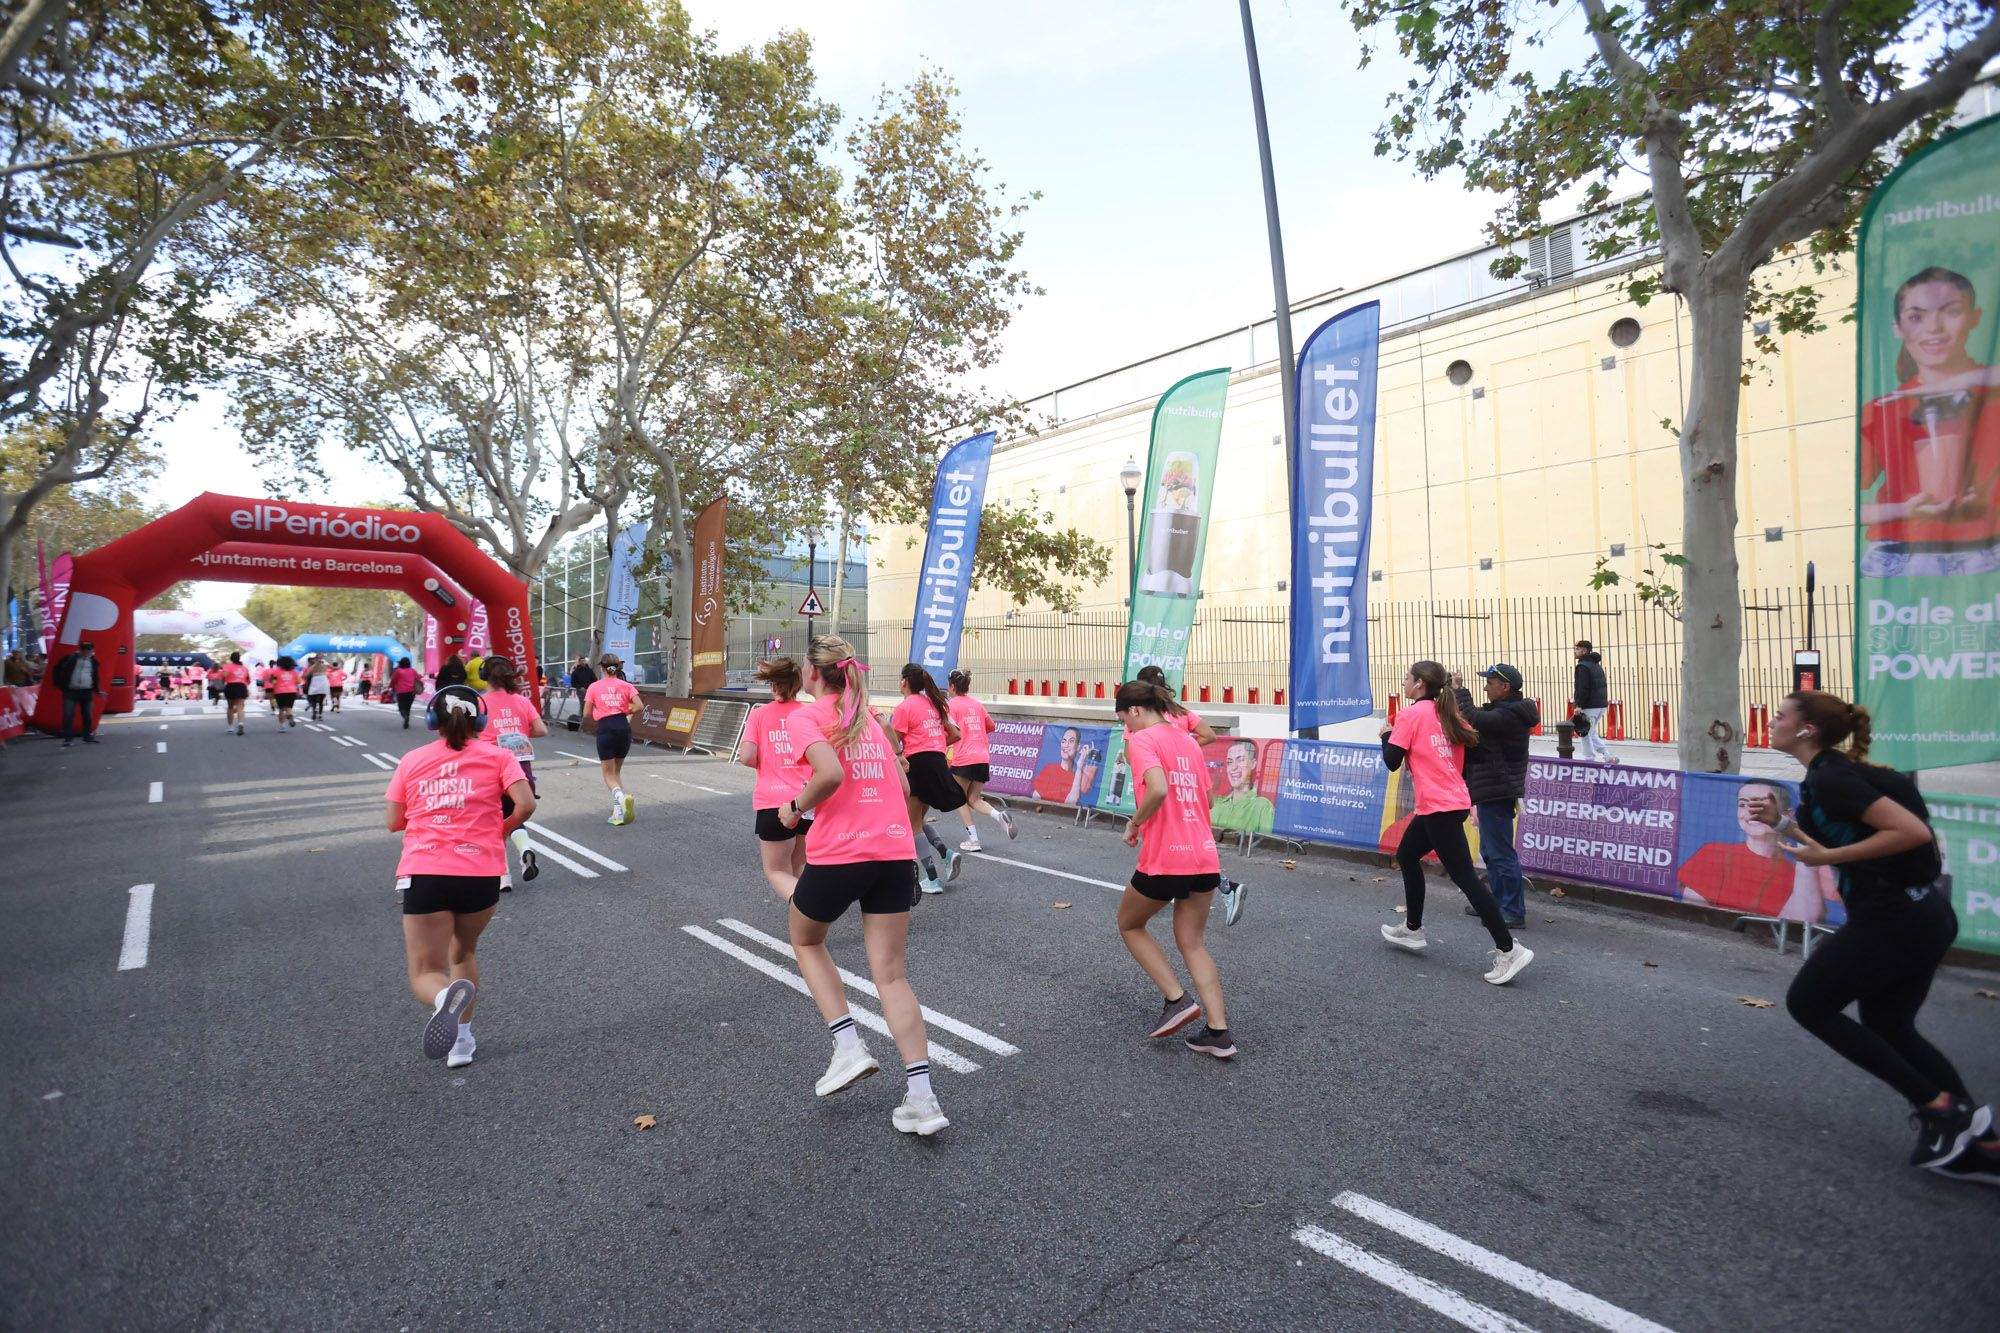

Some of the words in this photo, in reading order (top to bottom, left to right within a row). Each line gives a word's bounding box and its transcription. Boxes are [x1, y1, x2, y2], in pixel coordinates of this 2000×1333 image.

[1309, 363, 1360, 665] nutribullet
[230, 504, 421, 543] elPeriódico
[301, 558, 321, 571] de
[325, 559, 403, 575] Barcelona
[923, 469, 974, 668] nutribullet
[1868, 597, 1954, 626] Dale
[1132, 621, 1169, 639] Dale
[1173, 626, 1189, 640] al
[1129, 653, 1184, 671] POWER
[1868, 652, 2000, 680] POWER
[1297, 698, 1370, 706] www.nutribullet.es
[501, 708, 512, 718] TU
[995, 721, 1044, 736] UPERÑAMM
[988, 744, 1038, 758] UPERPOWER
[1289, 748, 1382, 769] nutribullet
[439, 760, 460, 777] TU
[852, 761, 885, 780] SUMA
[989, 765, 1034, 780] PERFRIEND
[1177, 756, 1190, 771] TU
[1530, 763, 1677, 790] SUPERÑAMM
[418, 778, 475, 796] DORSAL
[861, 787, 878, 797] 2024
[1326, 784, 1375, 799] nutrición,
[1527, 780, 1676, 809] SUPERHAPPY
[425, 795, 466, 811] SUMA
[1283, 790, 1318, 803] mínimo
[1320, 796, 1367, 810] esfuerzo.
[1525, 797, 1675, 829] SUPERPOWER
[1293, 823, 1344, 836] www.nutribullet.es
[1523, 815, 1673, 849] SUPERFUERTE
[1522, 832, 1672, 867] SUPERFRIEND
